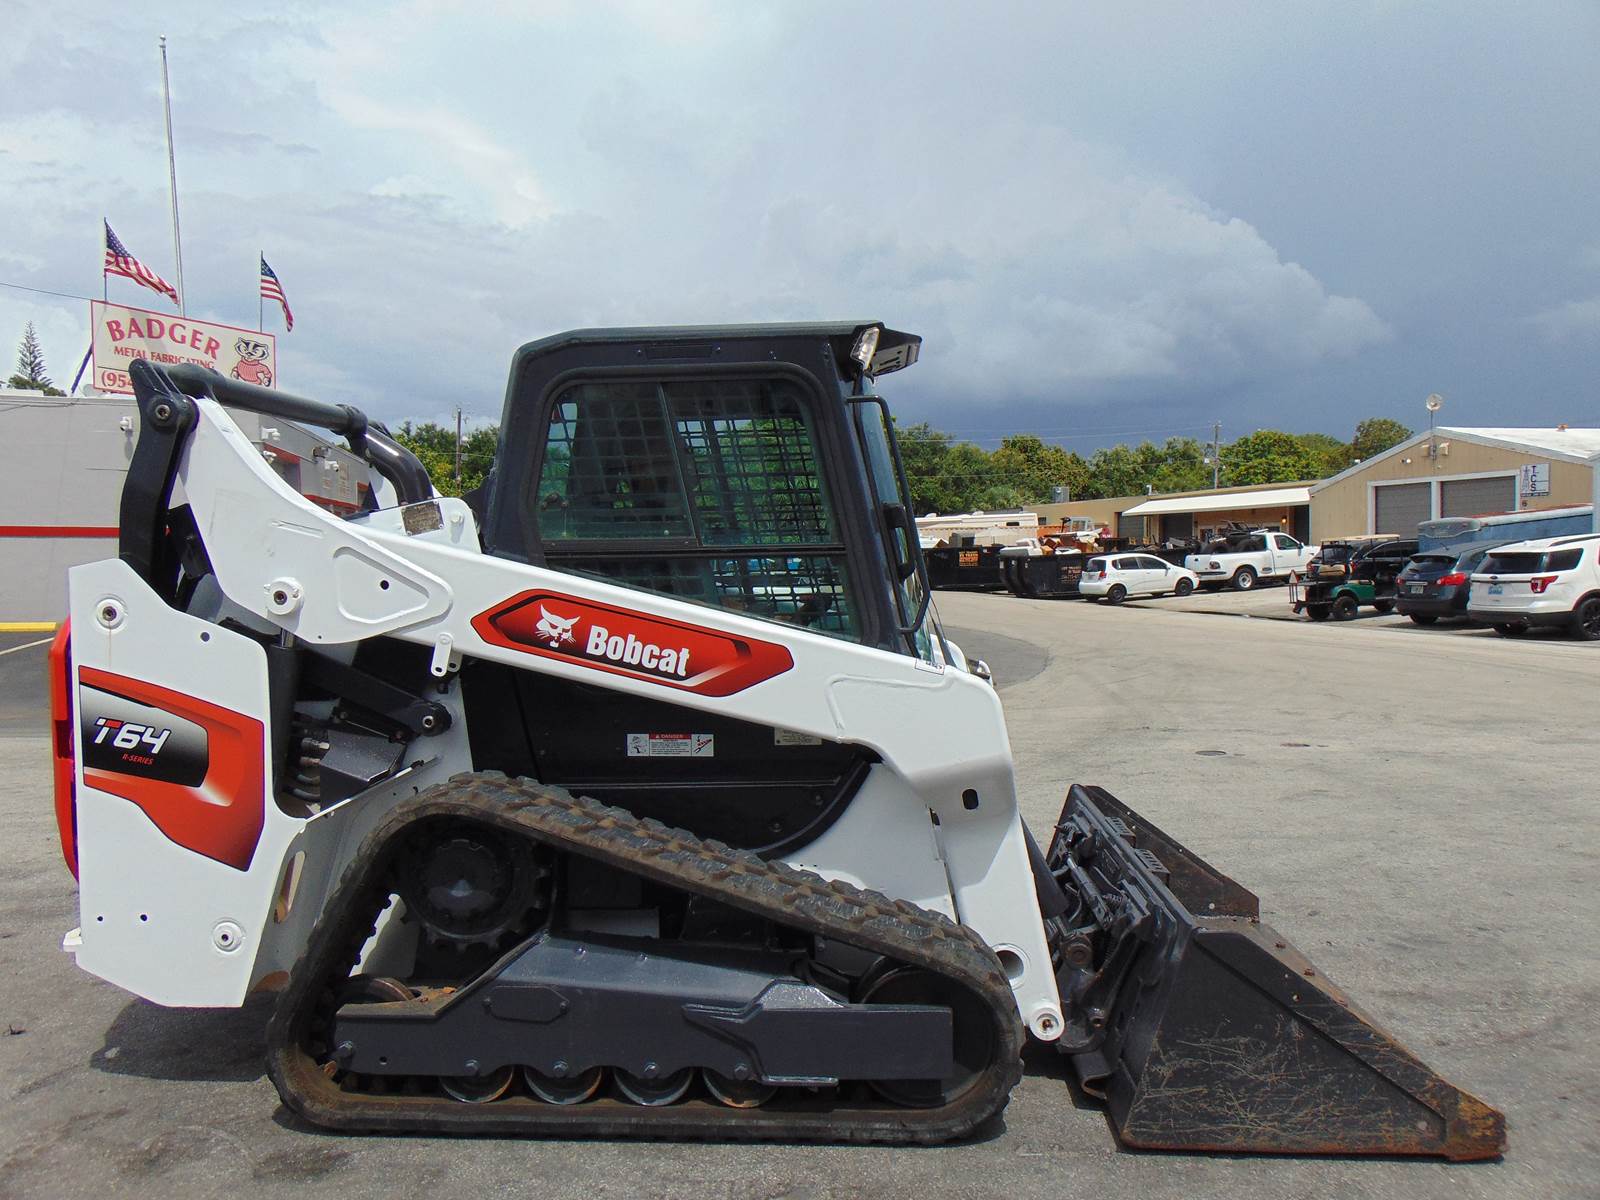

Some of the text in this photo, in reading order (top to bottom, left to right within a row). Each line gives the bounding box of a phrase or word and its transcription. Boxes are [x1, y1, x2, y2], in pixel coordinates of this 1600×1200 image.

[106, 318, 221, 360] BADGER
[114, 346, 148, 360] METAL
[585, 624, 690, 677] Bobcat
[94, 717, 172, 755] T64
[122, 753, 154, 765] R-SERIES
